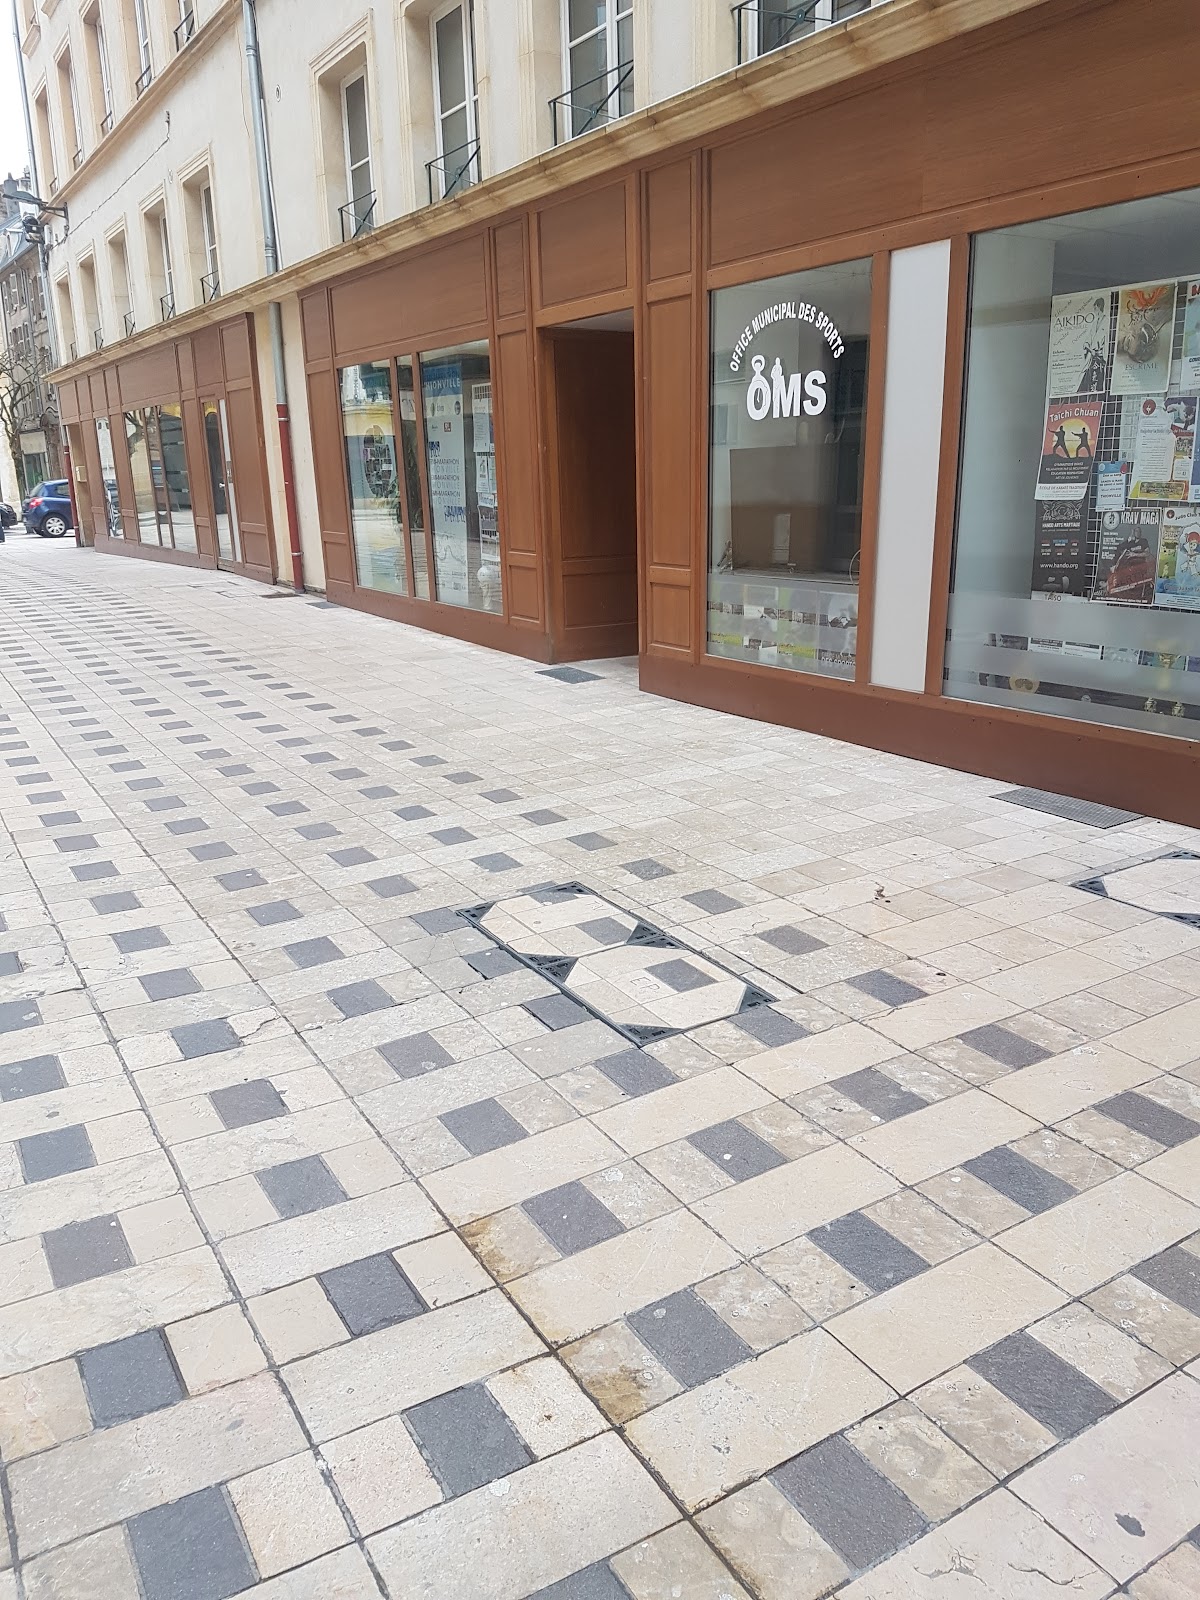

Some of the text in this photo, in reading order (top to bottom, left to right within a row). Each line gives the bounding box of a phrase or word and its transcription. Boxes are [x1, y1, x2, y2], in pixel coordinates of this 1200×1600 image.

[1054, 312, 1095, 327] AIKIDO
[729, 302, 845, 372] OFFICE MUNICIPAL DES SPORTS
[746, 368, 827, 420] OMS
[1074, 407, 1099, 419] Chuan
[1120, 511, 1160, 526] KRAV MAGA
[1040, 562, 1079, 570] www.hando.org
